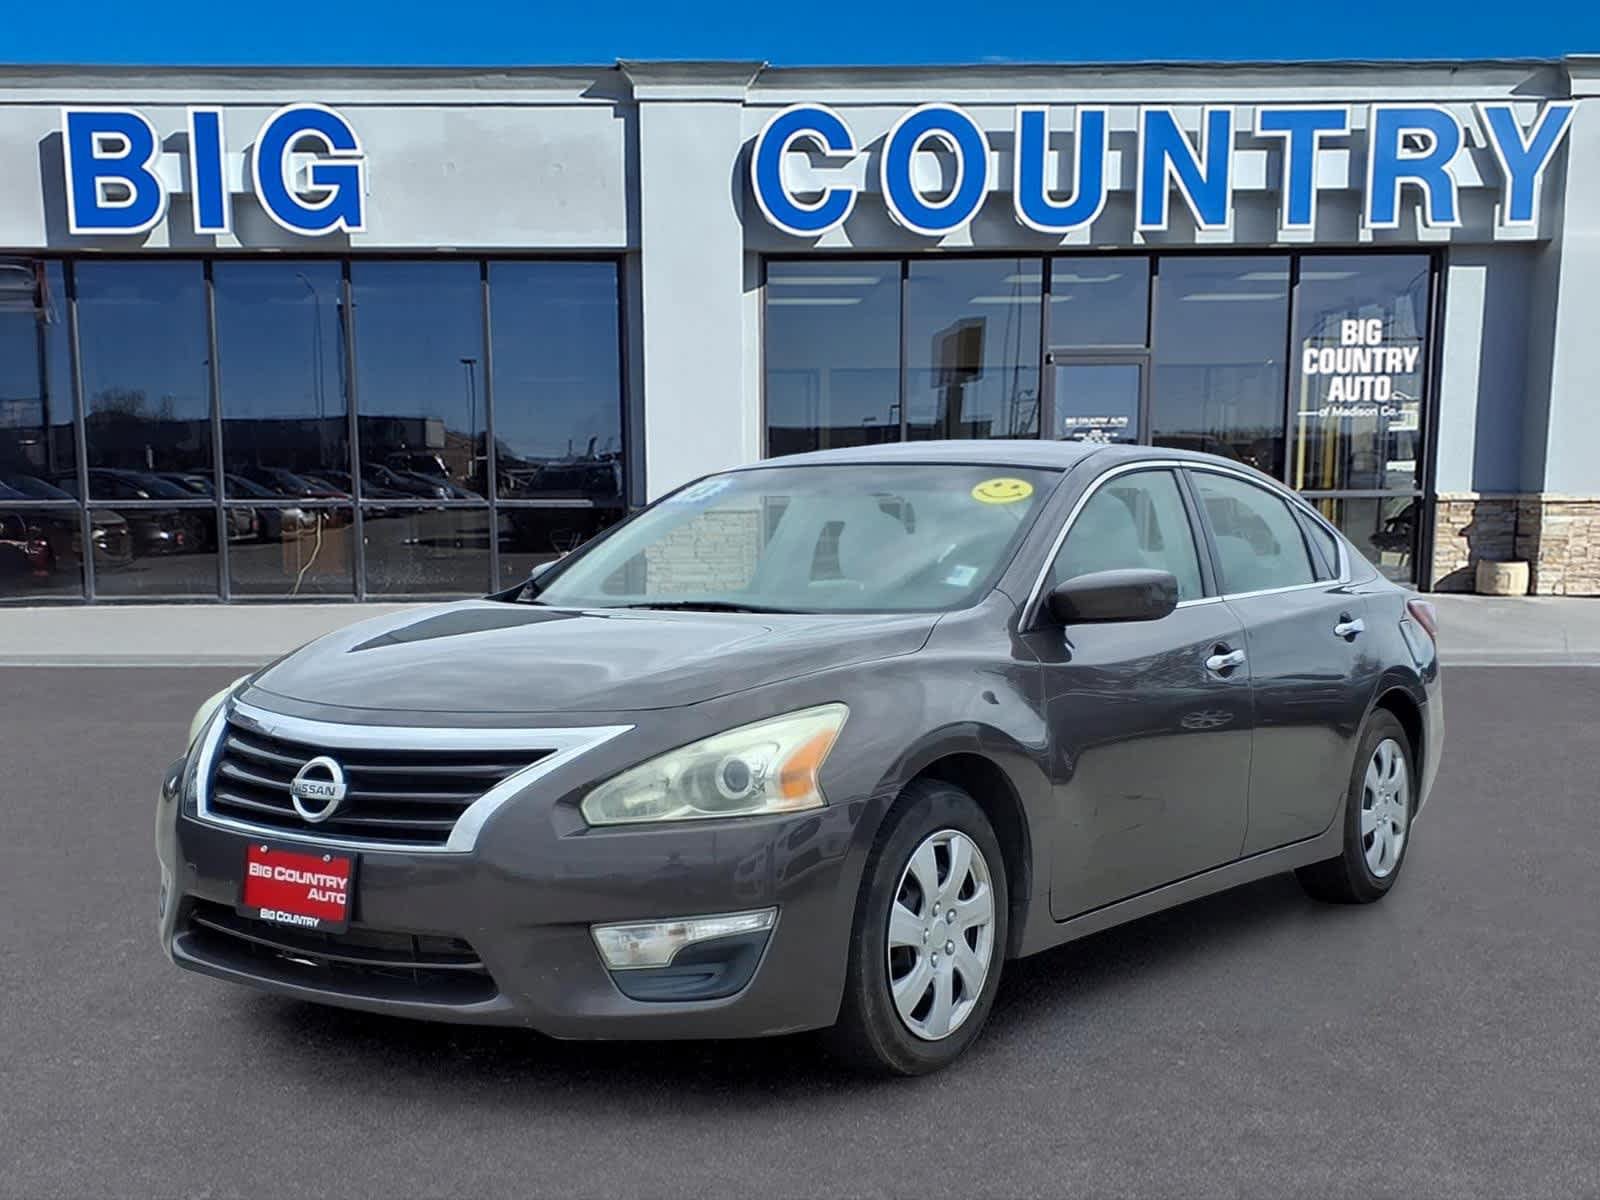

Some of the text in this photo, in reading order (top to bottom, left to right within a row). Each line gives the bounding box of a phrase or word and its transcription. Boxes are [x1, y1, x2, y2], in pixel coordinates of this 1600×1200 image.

[61, 101, 1575, 237] BIG COUNTRY
[1341, 318, 1382, 346] BIG
[1302, 346, 1419, 375] COUNTRY
[1327, 375, 1391, 402] AUTO
[291, 781, 336, 796] NISSAN
[249, 862, 348, 890] BIG COUNTRY
[307, 887, 347, 905] AUTO
[260, 907, 320, 929] BIG COUNTRY
